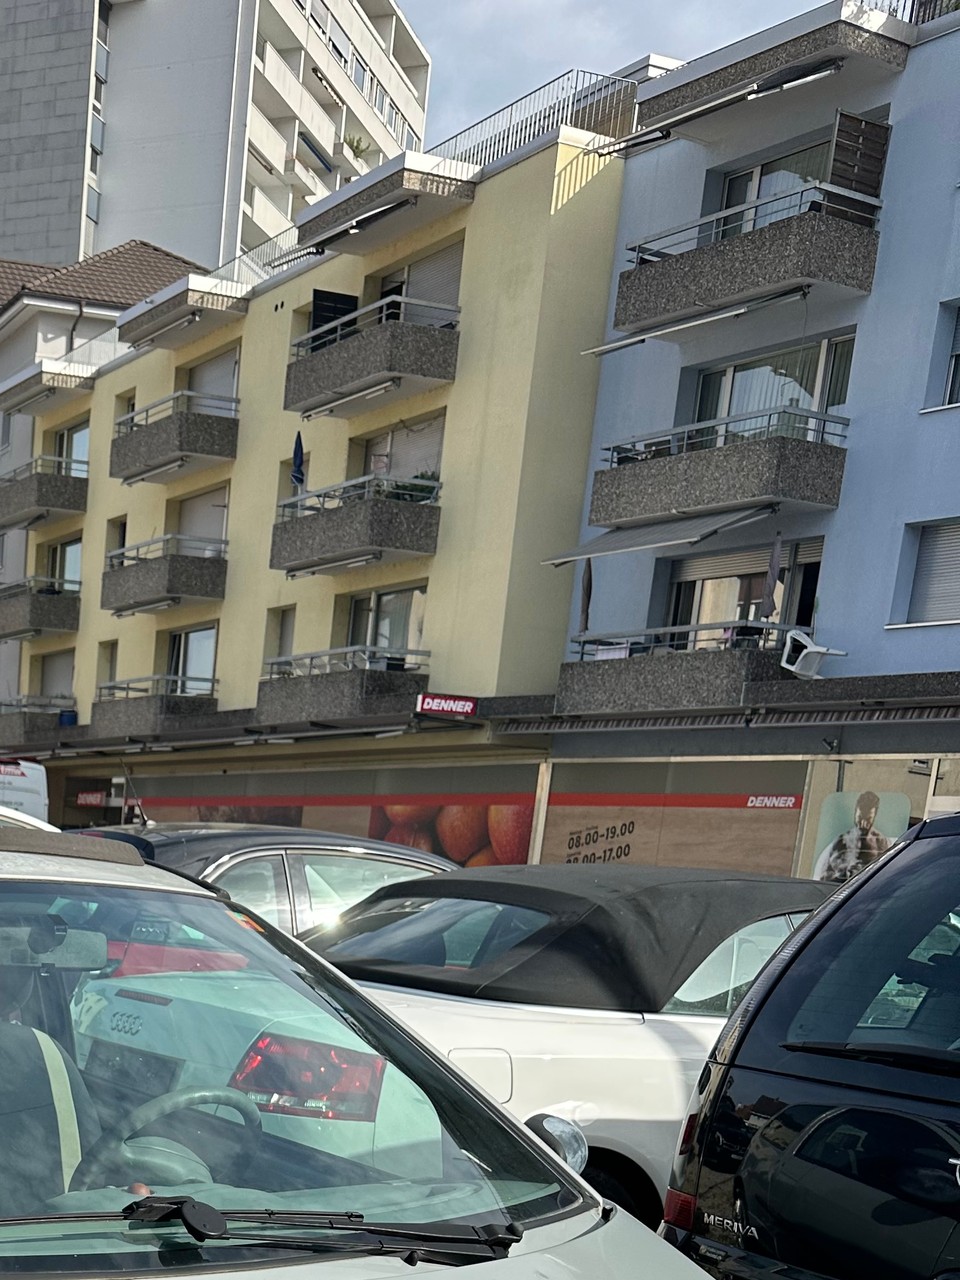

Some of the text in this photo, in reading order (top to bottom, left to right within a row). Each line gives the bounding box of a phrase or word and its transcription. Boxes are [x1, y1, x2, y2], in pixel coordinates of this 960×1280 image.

[423, 698, 474, 713] DENNER
[747, 796, 796, 808] DENNER
[568, 821, 635, 850] 08.00-19.00
[703, 1212, 759, 1240] MERIVA
